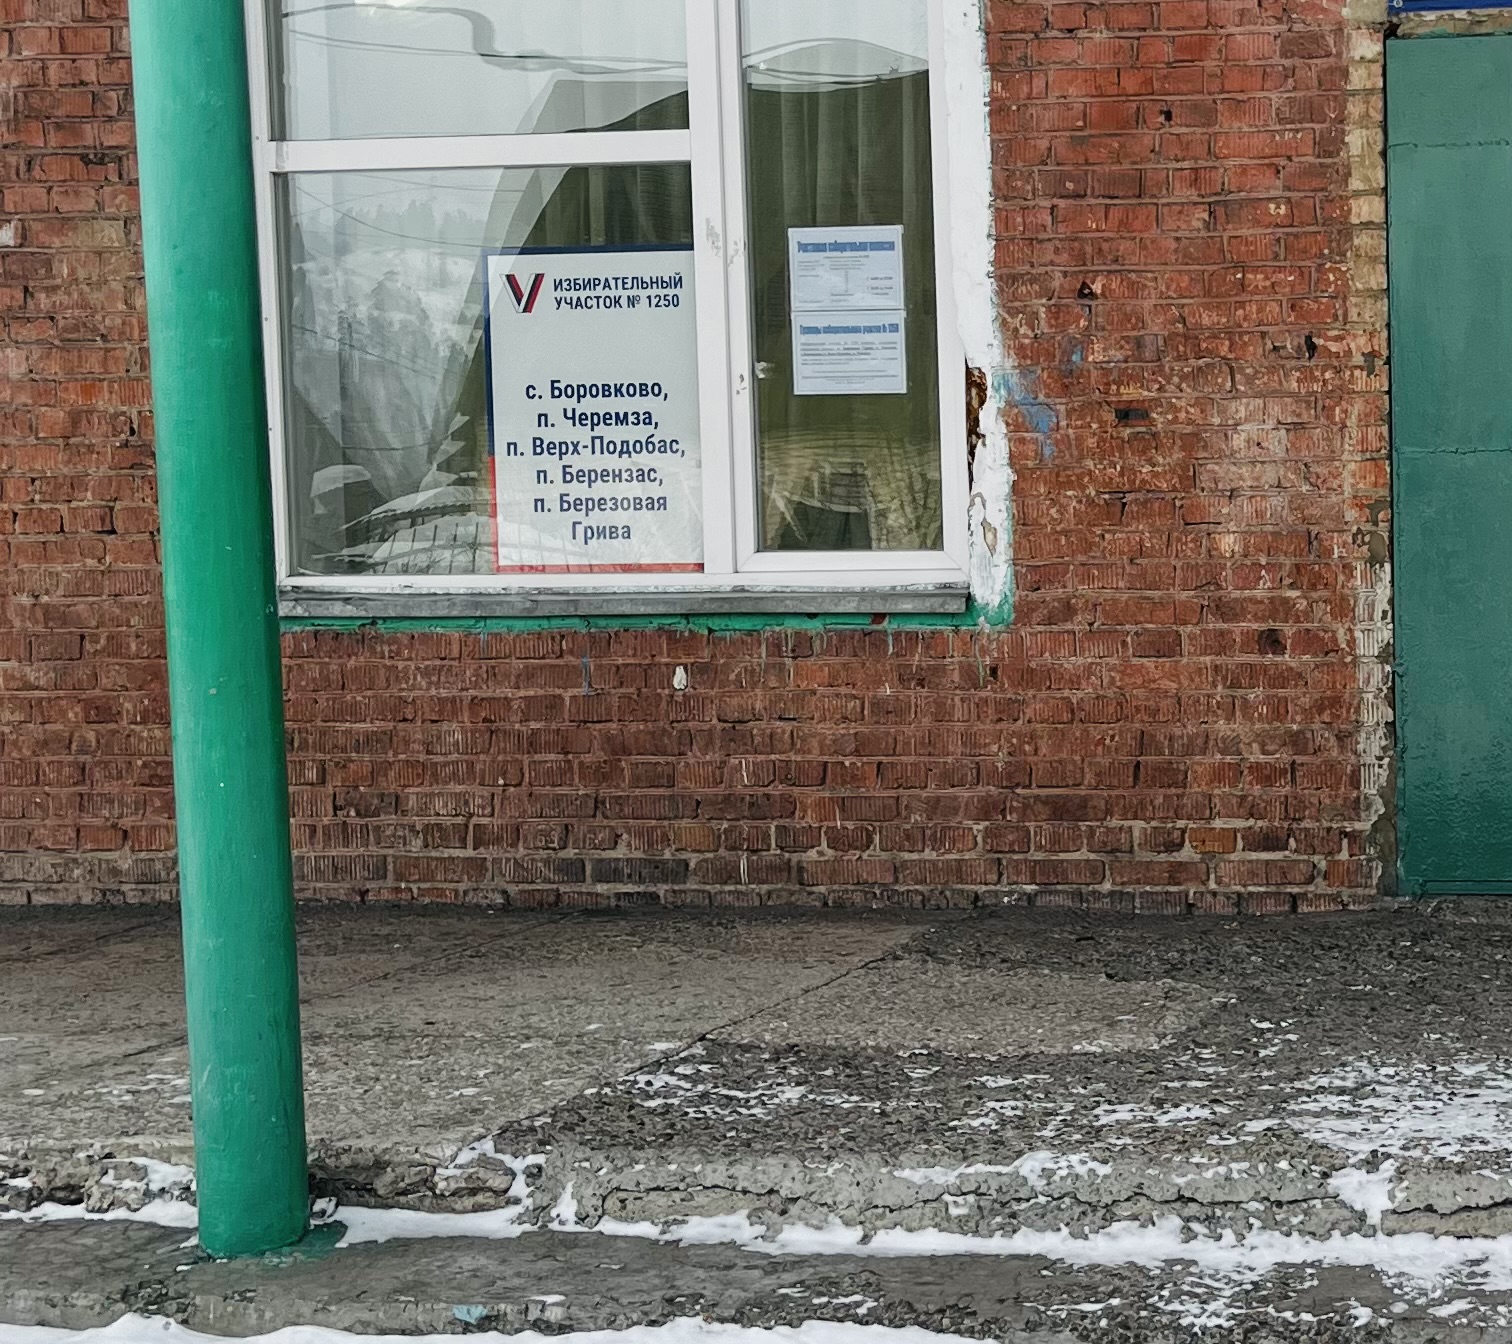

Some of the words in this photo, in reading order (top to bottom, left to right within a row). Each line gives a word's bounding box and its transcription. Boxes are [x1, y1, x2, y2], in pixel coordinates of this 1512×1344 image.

[553, 272, 684, 292] ИЗБИРАТЕЛЬНЫЙ
[554, 296, 623, 310] УЧАСТОК
[627, 295, 641, 309] №
[646, 294, 680, 308] 1250
[525, 383, 543, 400] с.
[550, 380, 669, 403] Боровково,
[537, 412, 556, 428] п.
[563, 407, 659, 432] Черемза,
[506, 441, 525, 457] п.
[532, 434, 686, 460] Верх-Подобас,
[536, 469, 555, 484] п.
[562, 465, 664, 488] Берензас,
[534, 497, 552, 513] п.
[559, 493, 668, 517] Березовая
[571, 521, 632, 545] Грива
